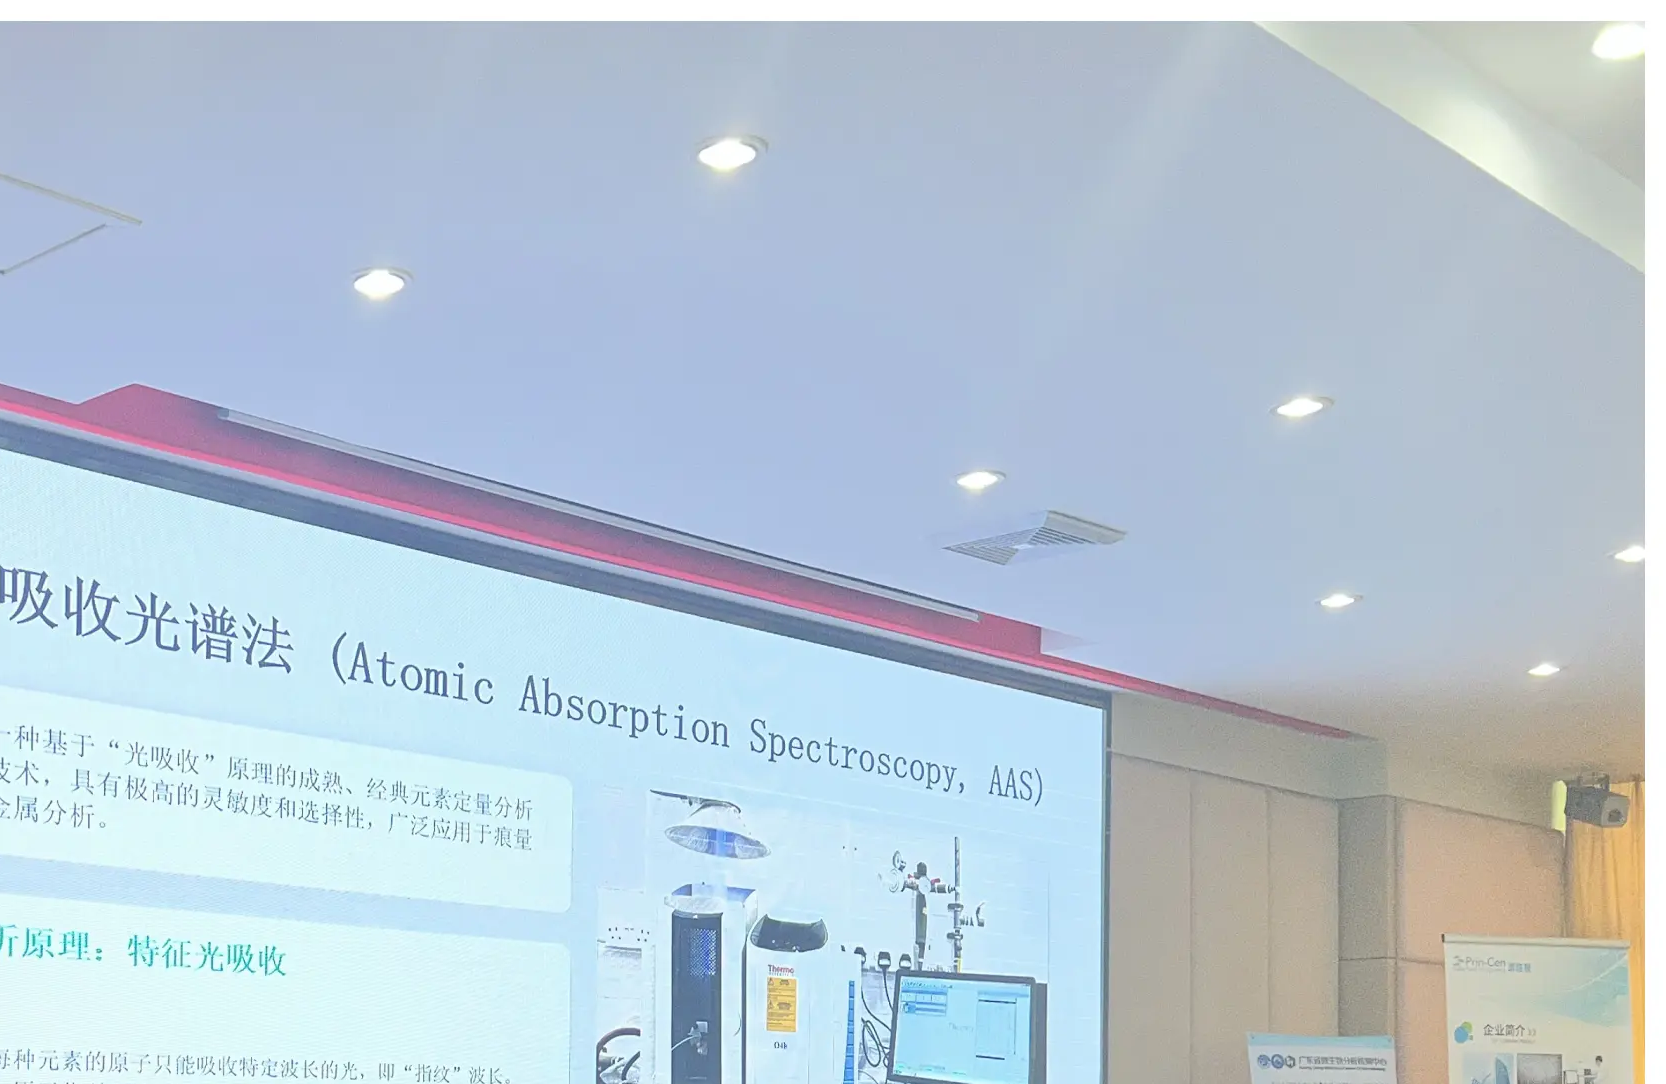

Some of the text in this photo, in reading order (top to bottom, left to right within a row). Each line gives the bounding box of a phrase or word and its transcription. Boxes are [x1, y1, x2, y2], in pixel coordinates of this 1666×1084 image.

[331, 631, 1043, 808] (Atomic Absorption Spectroscopy, AAS)
[1483, 1023, 1526, 1037] 企业简介
